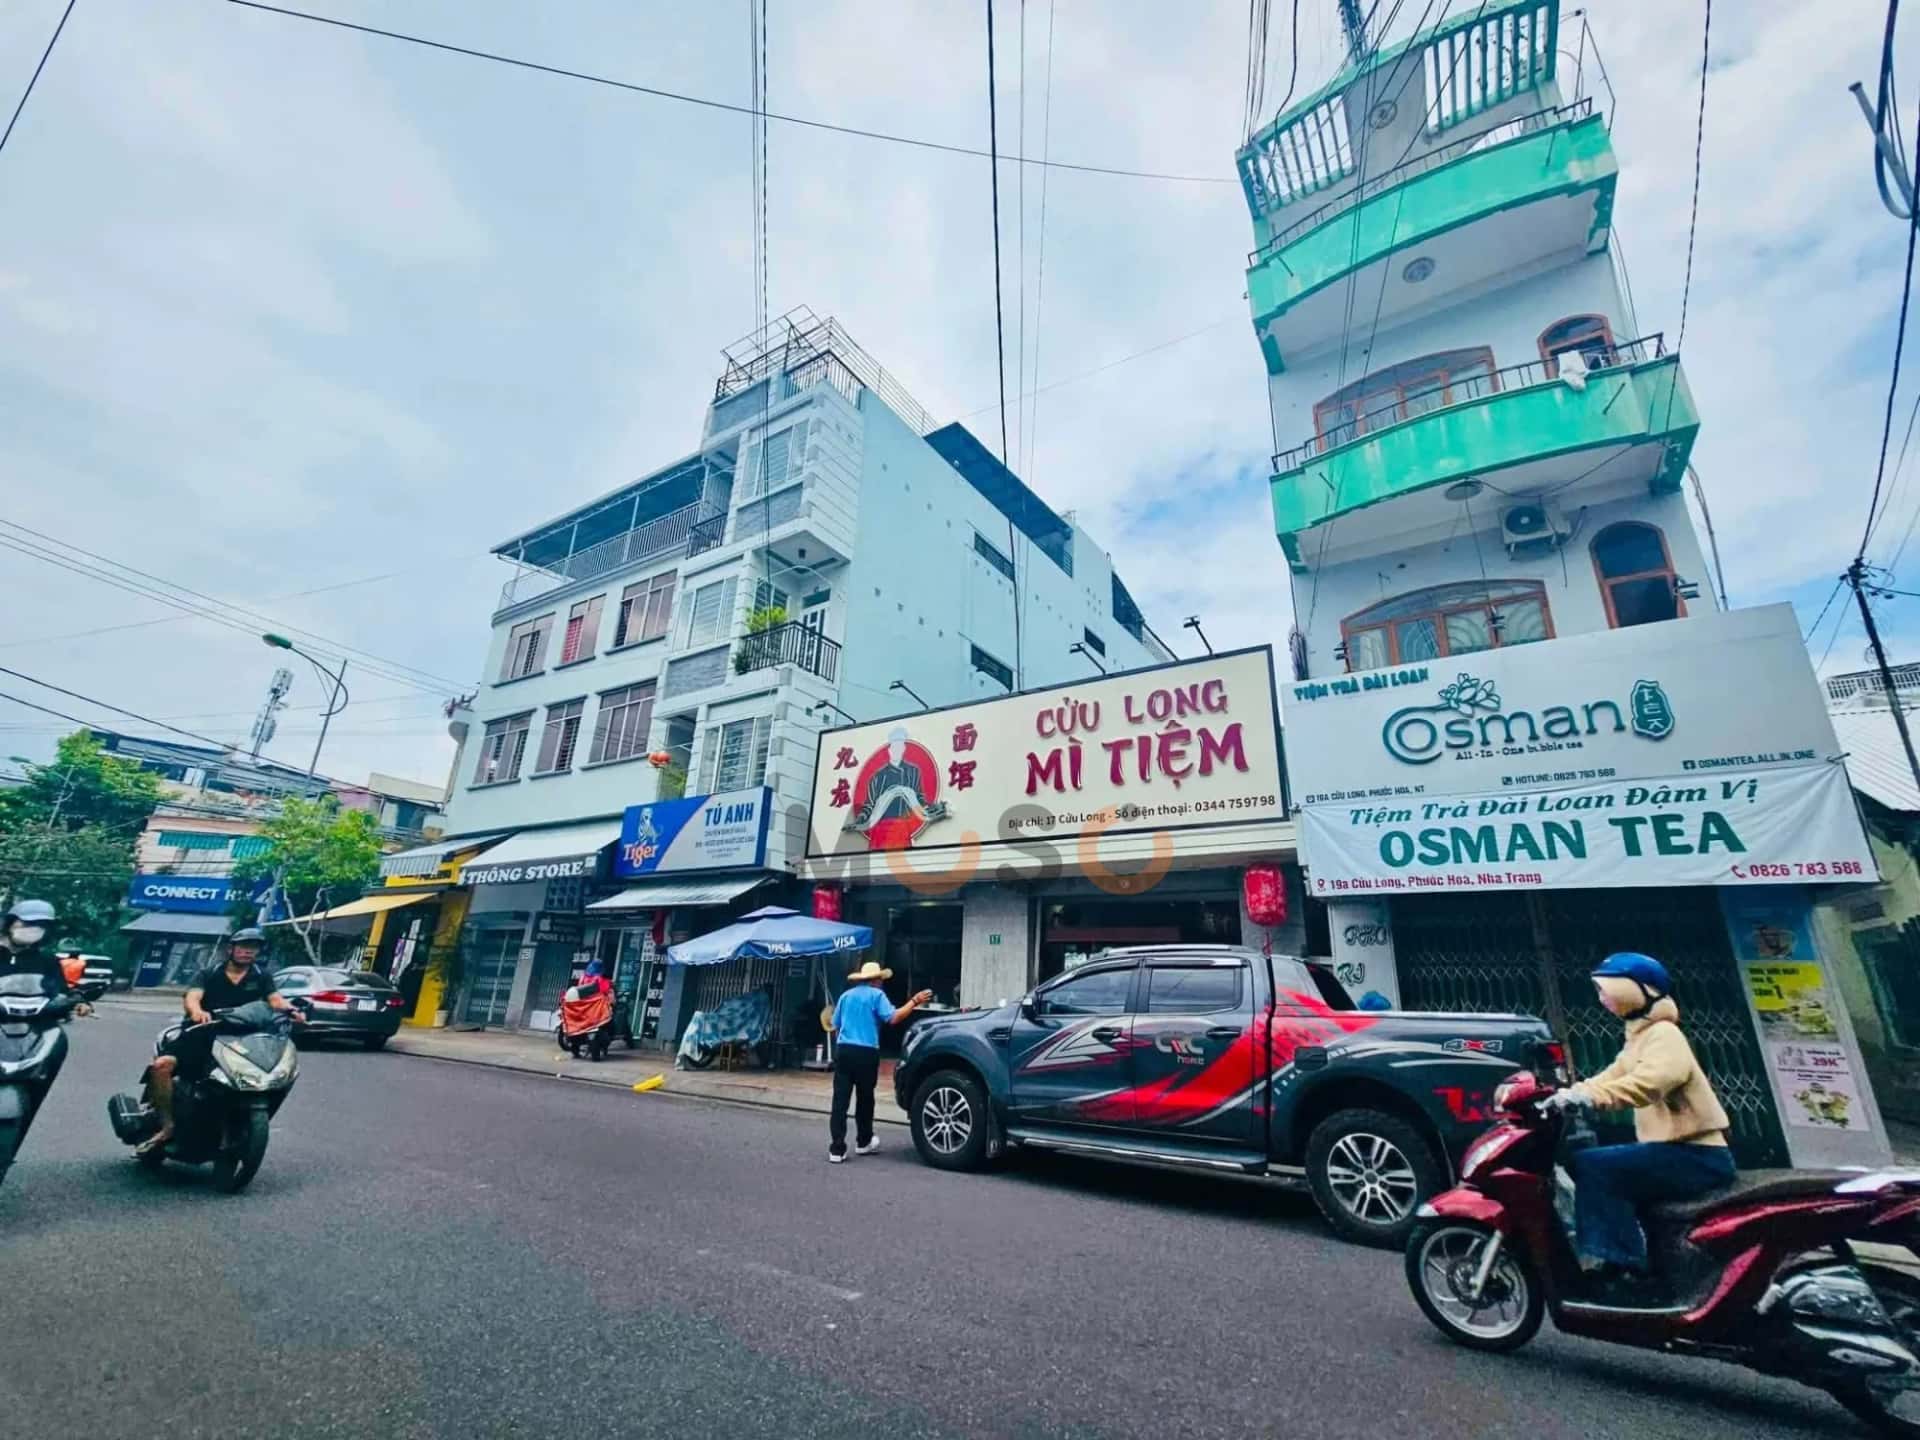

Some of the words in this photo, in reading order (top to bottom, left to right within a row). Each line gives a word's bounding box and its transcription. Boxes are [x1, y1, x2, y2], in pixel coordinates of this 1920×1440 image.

[1330, 676, 1360, 696] TRÀ
[1391, 668, 1429, 687] LOAN
[1036, 697, 1100, 738] CỬU
[1124, 679, 1229, 724] LONG
[1025, 736, 1084, 796] MÌ
[1101, 719, 1249, 790] TIỆM
[725, 803, 754, 825] ANH
[1046, 815, 1056, 825] 17
[1059, 812, 1078, 824] Cửu
[1080, 811, 1105, 824] Long
[1157, 803, 1192, 817] thoại:
[1195, 800, 1226, 812] 0344
[1230, 795, 1276, 808] 759798
[1350, 806, 1411, 828] Tiệm
[1421, 800, 1468, 820] Trà
[1478, 796, 1528, 817] Đài
[1536, 794, 1613, 812] Loan
[1625, 785, 1707, 809] Đậm
[1721, 779, 1758, 804] Vị
[1379, 819, 1587, 867] OSMAN
[1608, 811, 1747, 857] TEA
[624, 839, 660, 868] Tiger
[466, 866, 522, 885] THÔNG
[525, 861, 583, 880] STORE
[1750, 864, 1790, 877] 0826
[1795, 863, 1827, 876] 783
[1832, 861, 1862, 874] 588
[143, 885, 221, 900] CONNECT
[768, 943, 793, 954] VISA
[832, 936, 856, 949] VISA
